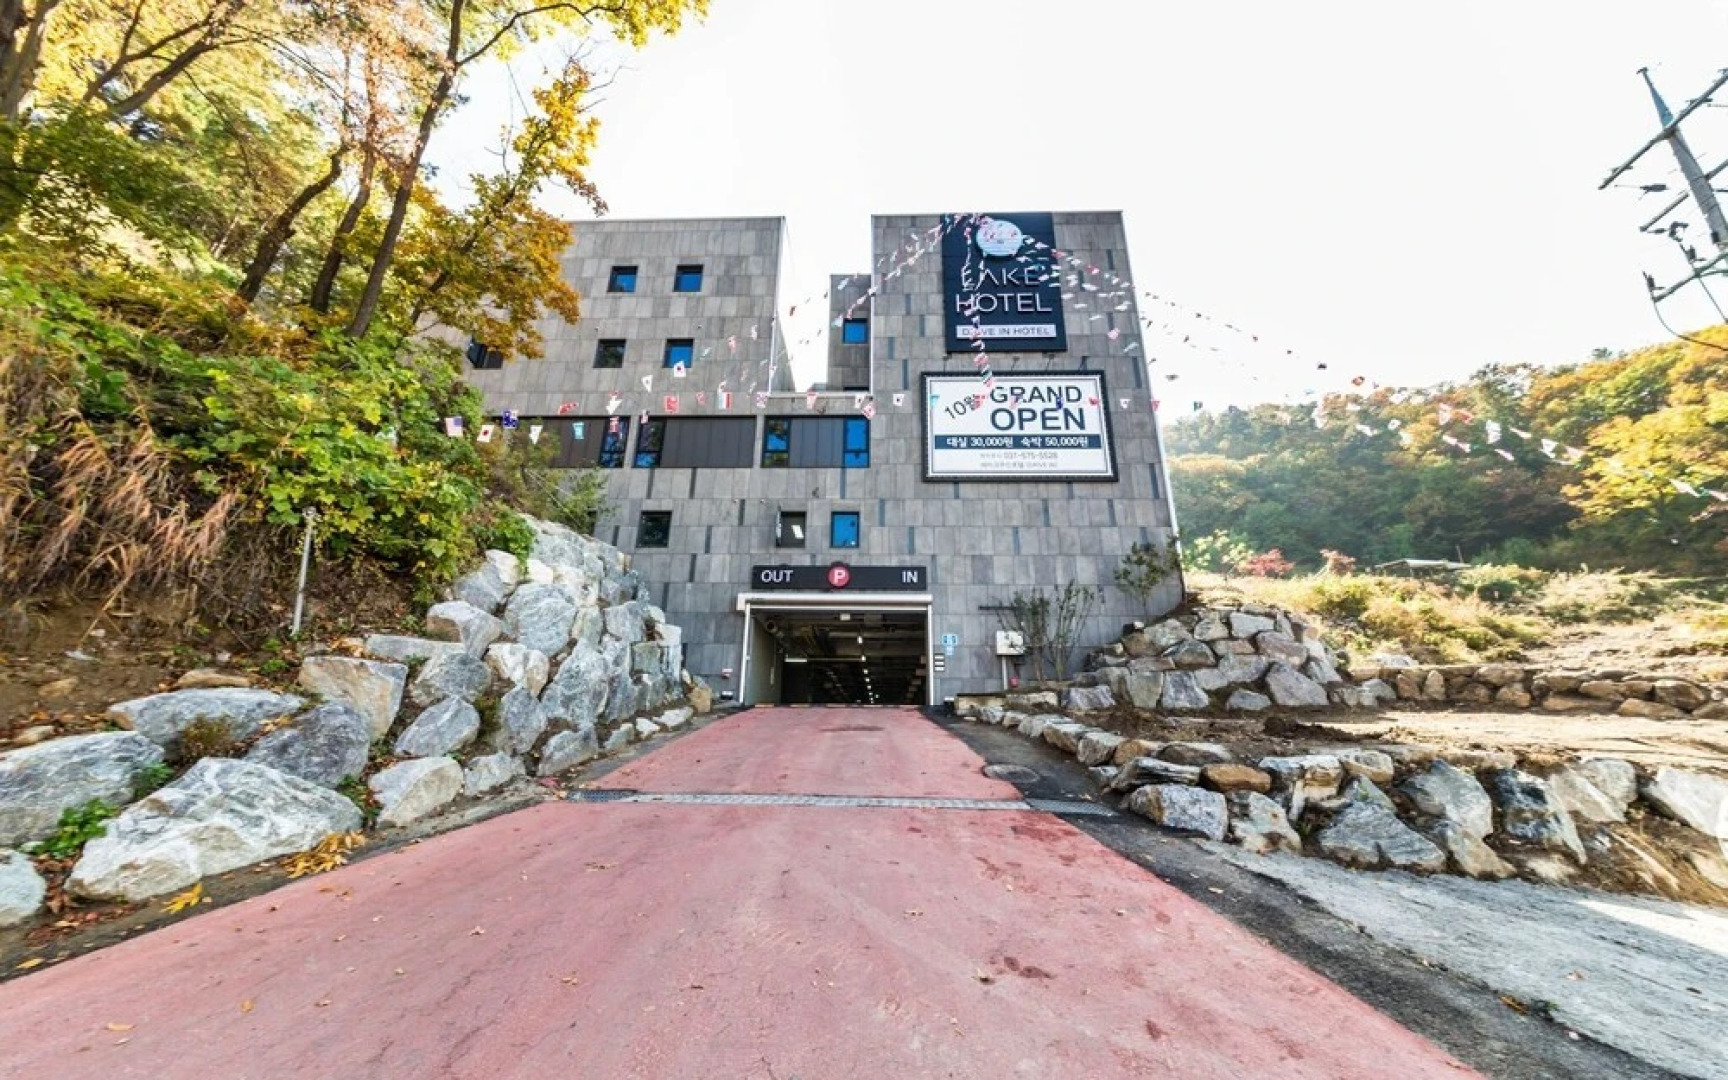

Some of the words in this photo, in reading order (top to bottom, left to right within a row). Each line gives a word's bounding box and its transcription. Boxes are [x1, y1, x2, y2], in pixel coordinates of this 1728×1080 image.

[955, 293, 1053, 313] HOTEL
[999, 327, 1010, 335] IN
[1013, 326, 1050, 335] HOTEL
[990, 386, 1082, 404] GRAND
[990, 408, 1086, 431] OPEN
[947, 437, 967, 449] 대실
[970, 437, 1014, 449] 30,000원
[1020, 437, 1042, 449] 숙박
[1045, 437, 1088, 449] 50,000원
[761, 569, 794, 583] OUT
[834, 569, 846, 584] P
[902, 569, 918, 584] IN
